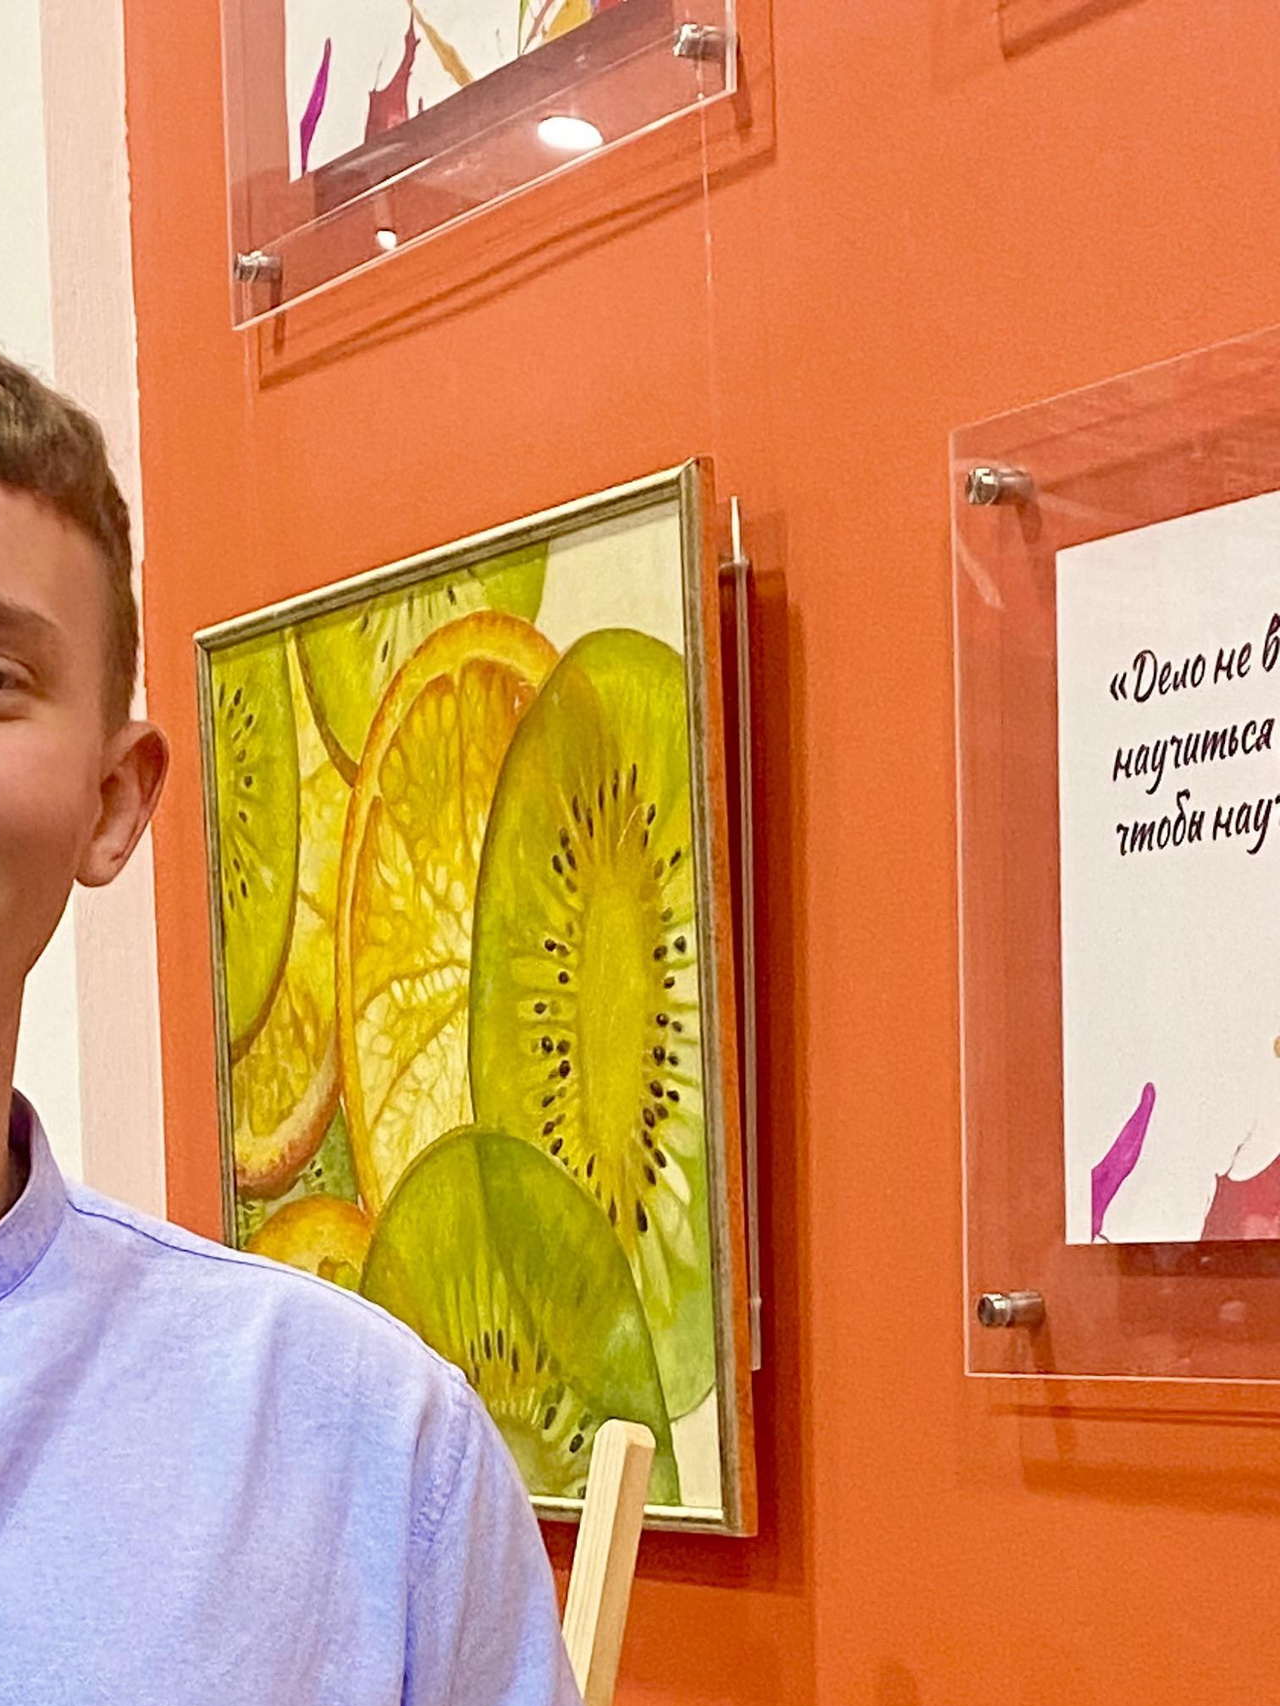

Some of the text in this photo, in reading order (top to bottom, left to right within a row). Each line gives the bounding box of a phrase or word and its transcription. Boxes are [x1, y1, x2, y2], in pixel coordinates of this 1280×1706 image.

[1110, 649, 1207, 703] «Дело
[1214, 641, 1252, 685] не
[1112, 718, 1276, 795] научиться
[1116, 788, 1280, 857] чтобы нау
